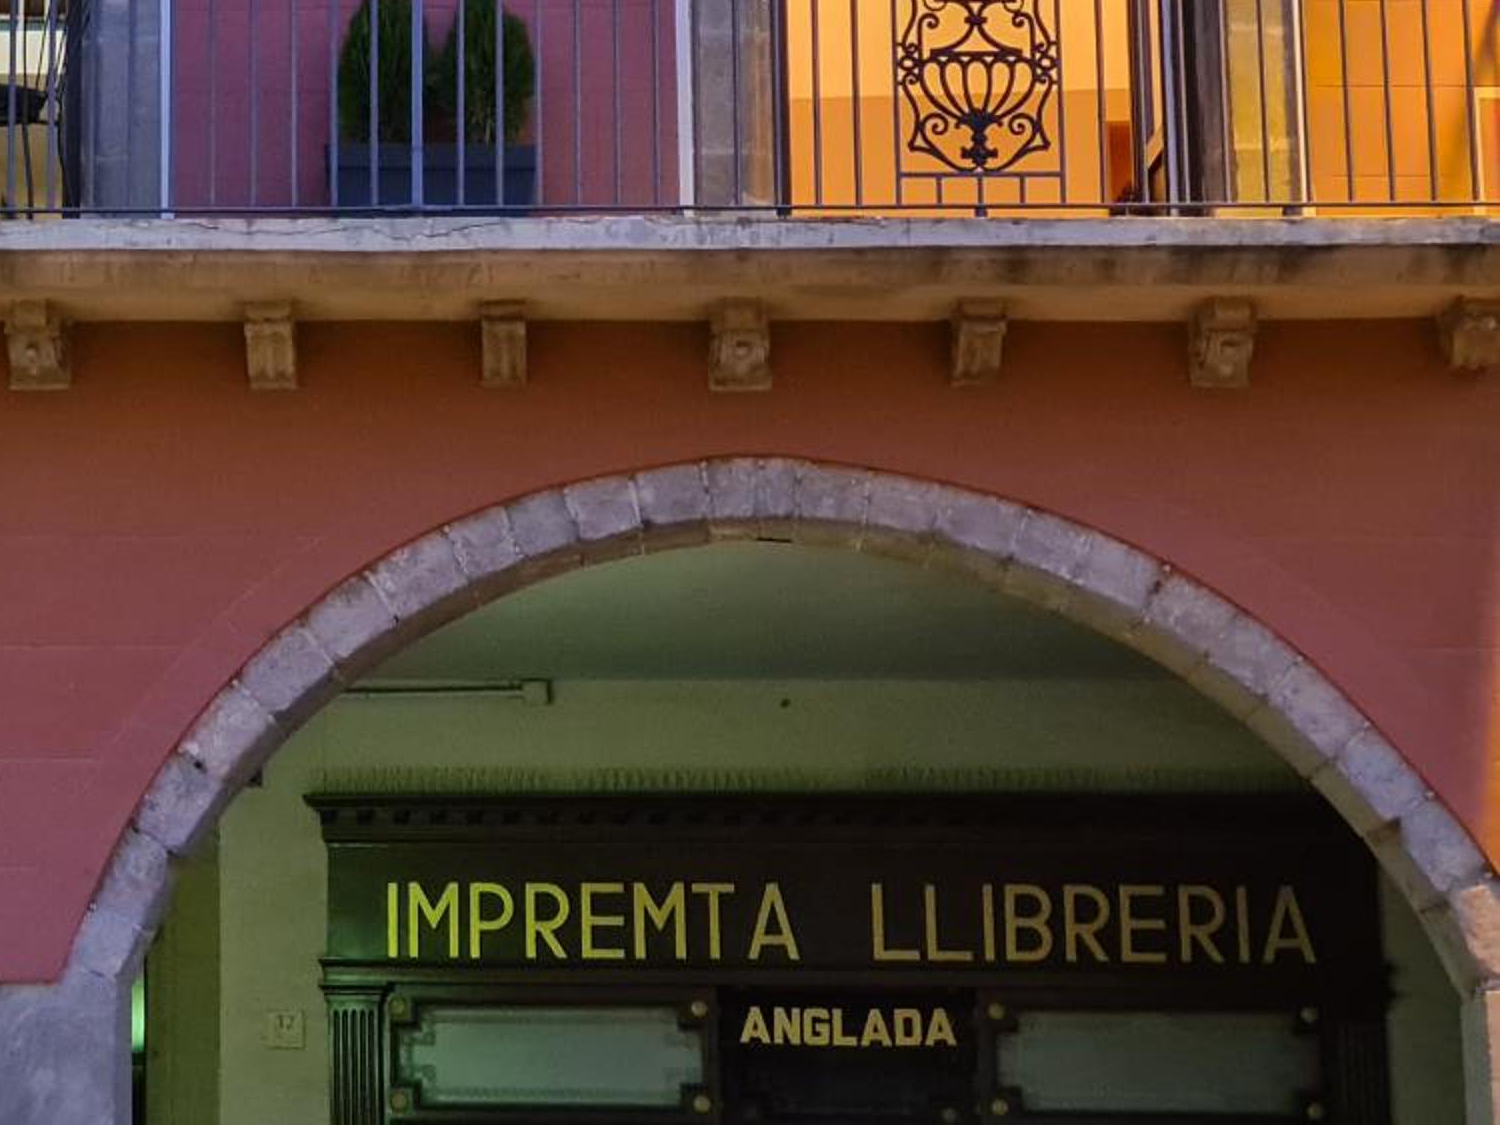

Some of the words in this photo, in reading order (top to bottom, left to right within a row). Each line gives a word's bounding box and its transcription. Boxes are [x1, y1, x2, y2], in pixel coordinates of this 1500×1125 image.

[386, 880, 800, 961] IMPREMTA
[870, 881, 1317, 964] LLIBRERIA
[739, 1005, 957, 1047] ANGLADA
